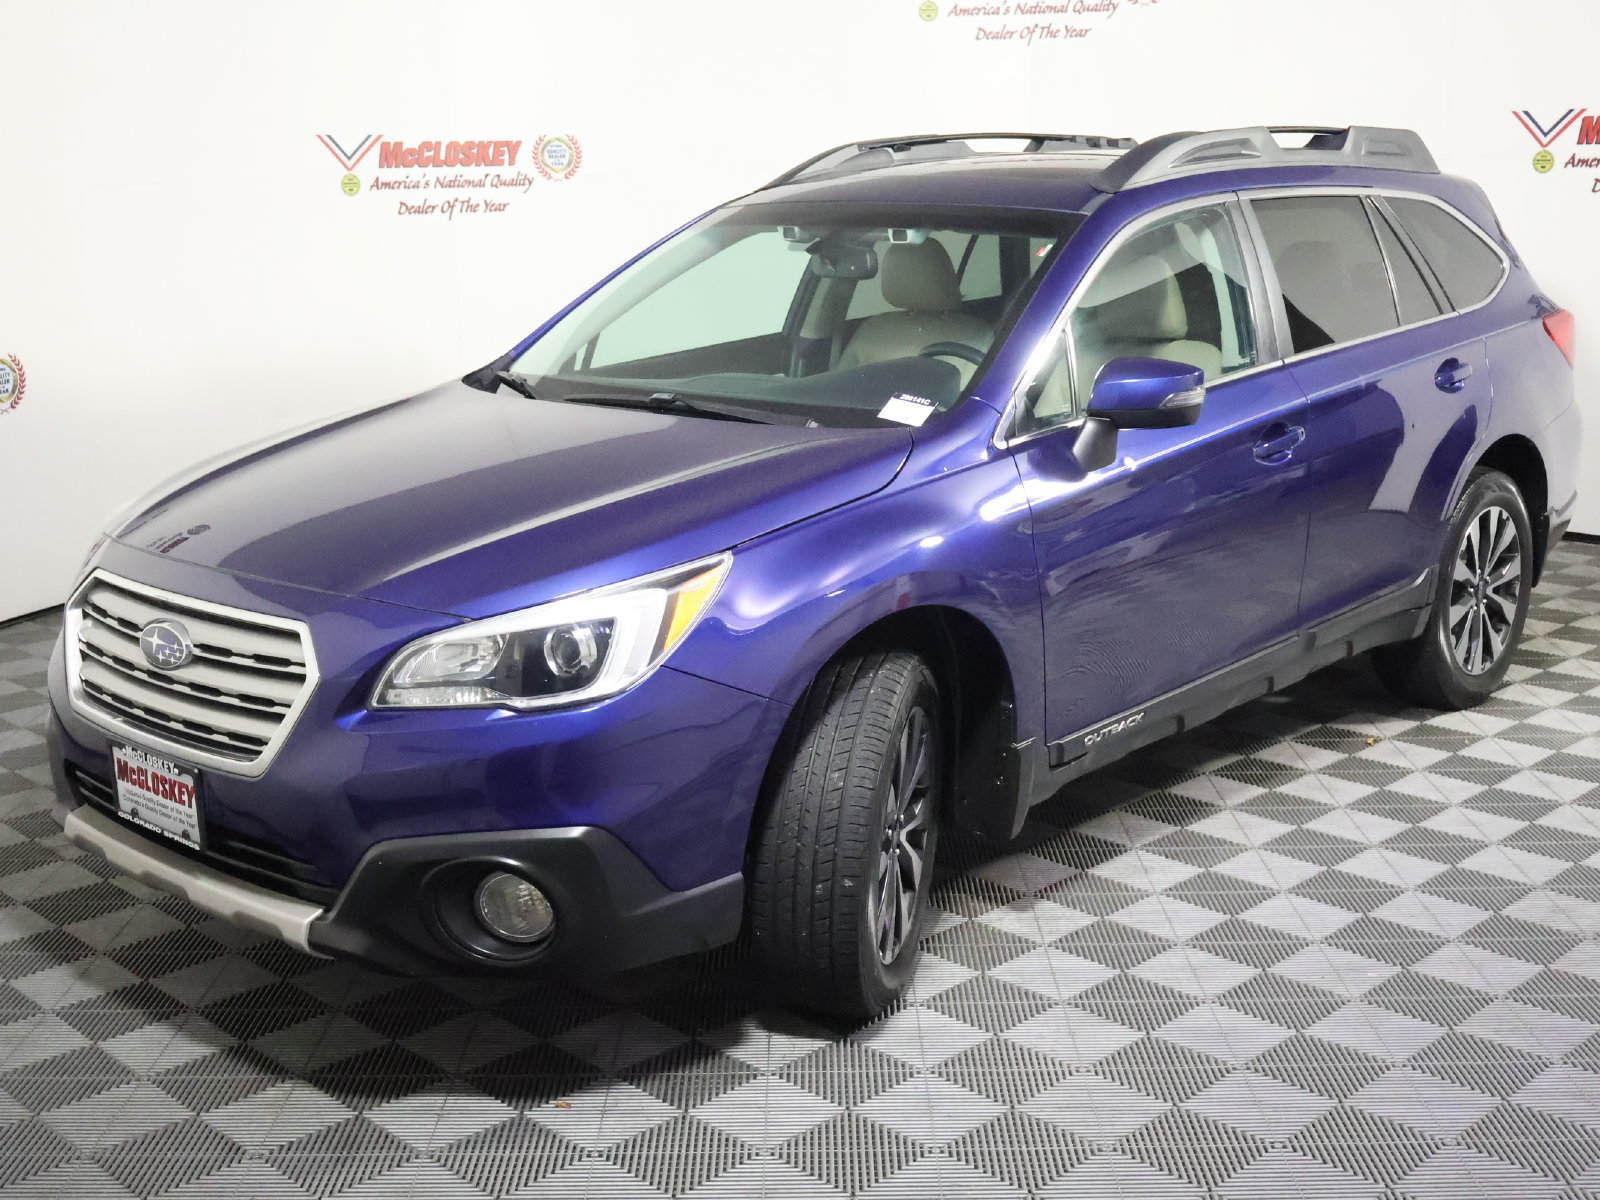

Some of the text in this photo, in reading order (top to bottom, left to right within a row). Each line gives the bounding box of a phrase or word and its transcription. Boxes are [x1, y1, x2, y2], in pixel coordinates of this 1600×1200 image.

[947, 0, 1010, 17] America's
[1014, 0, 1070, 15] National
[1072, 0, 1119, 19] Quality
[976, 23, 1092, 46] Dealer Of The Year
[379, 140, 522, 168] McCLOSKEY
[370, 172, 430, 191] America's
[434, 174, 490, 189] National
[491, 171, 534, 194] Quality
[398, 197, 509, 221] Dealer Of The Year
[1084, 712, 1145, 745] OUTBACK
[125, 745, 175, 774] McCLOSKEY
[116, 757, 196, 809] McCLOSKEY
[117, 811, 162, 834] COLORADO
